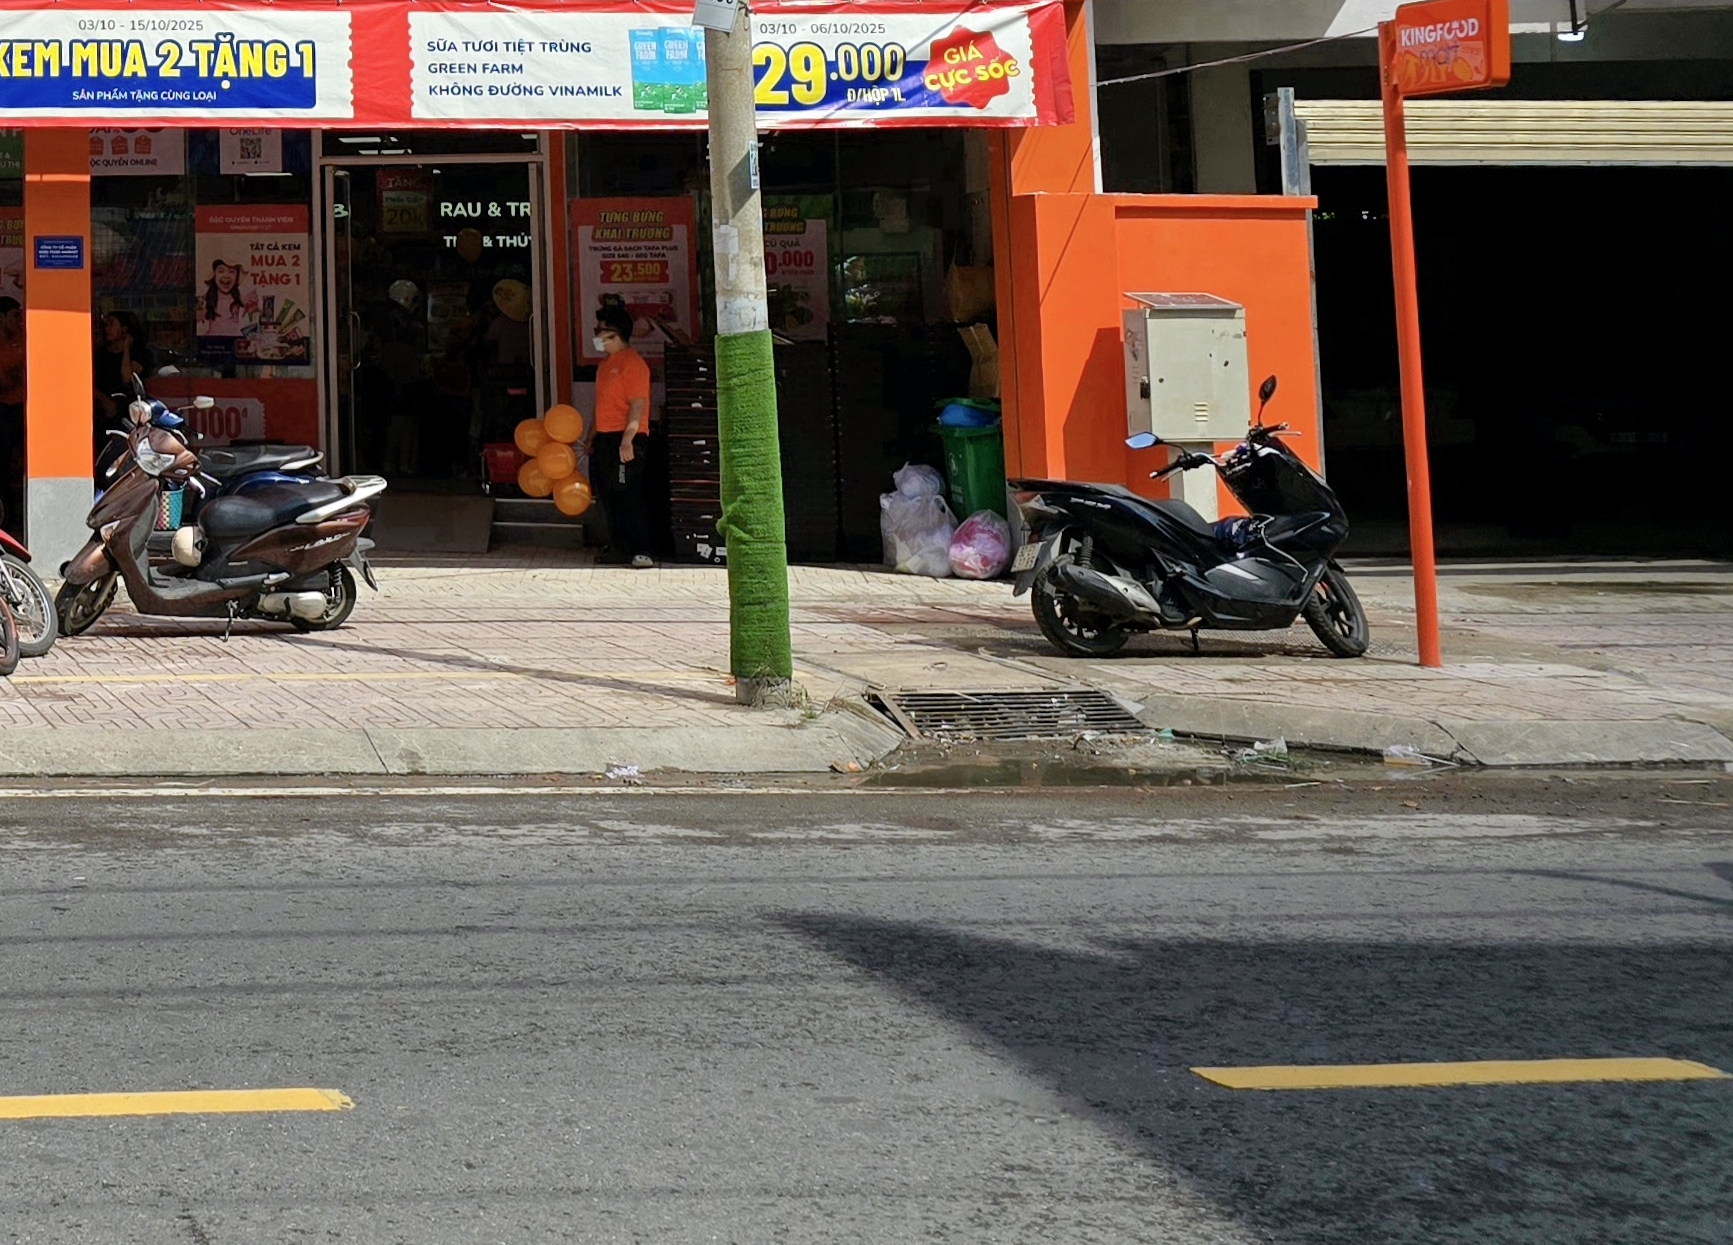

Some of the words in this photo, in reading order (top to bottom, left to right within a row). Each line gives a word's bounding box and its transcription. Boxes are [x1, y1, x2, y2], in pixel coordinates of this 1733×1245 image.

[78, 19, 116, 31] 03/10
[130, 19, 204, 31] 15/10/2025
[760, 23, 797, 35] 03/10
[810, 23, 886, 35] 06/10/2025
[1401, 18, 1479, 47] KINGFOOD
[427, 38, 458, 53] SỮA
[462, 39, 498, 52] TƯƠI
[503, 38, 535, 56] TIỆT
[539, 39, 592, 53] TRÙNG
[944, 40, 984, 65] GIÁ
[71, 39, 148, 79] MUA
[158, 39, 182, 79] 2
[190, 33, 290, 90] TẶNG
[297, 39, 316, 79] 1
[428, 63, 477, 74] GREEN
[482, 63, 523, 74] FARM
[752, 41, 907, 105] 29.000
[924, 68, 972, 93] CỰC
[977, 57, 1020, 82] SỐC
[72, 89, 95, 101] SẢN
[96, 87, 128, 101] PHẨM
[129, 89, 159, 102] TẶNG
[161, 88, 191, 101] CÙNG
[192, 89, 217, 103] LOẠI
[428, 83, 484, 96] KHÔNG
[487, 83, 544, 97] ĐƯỜNG
[548, 85, 623, 97] VINAMILK
[847, 87, 889, 105] Đ/HỘP
[440, 201, 481, 218] RAU
[487, 201, 501, 218] &
[282, 243, 301, 251] KEM
[251, 255, 287, 267] MUA
[291, 255, 301, 267] 2
[250, 270, 291, 287] TẶNG
[295, 273, 301, 285] 1
[610, 262, 661, 282] 23.500
